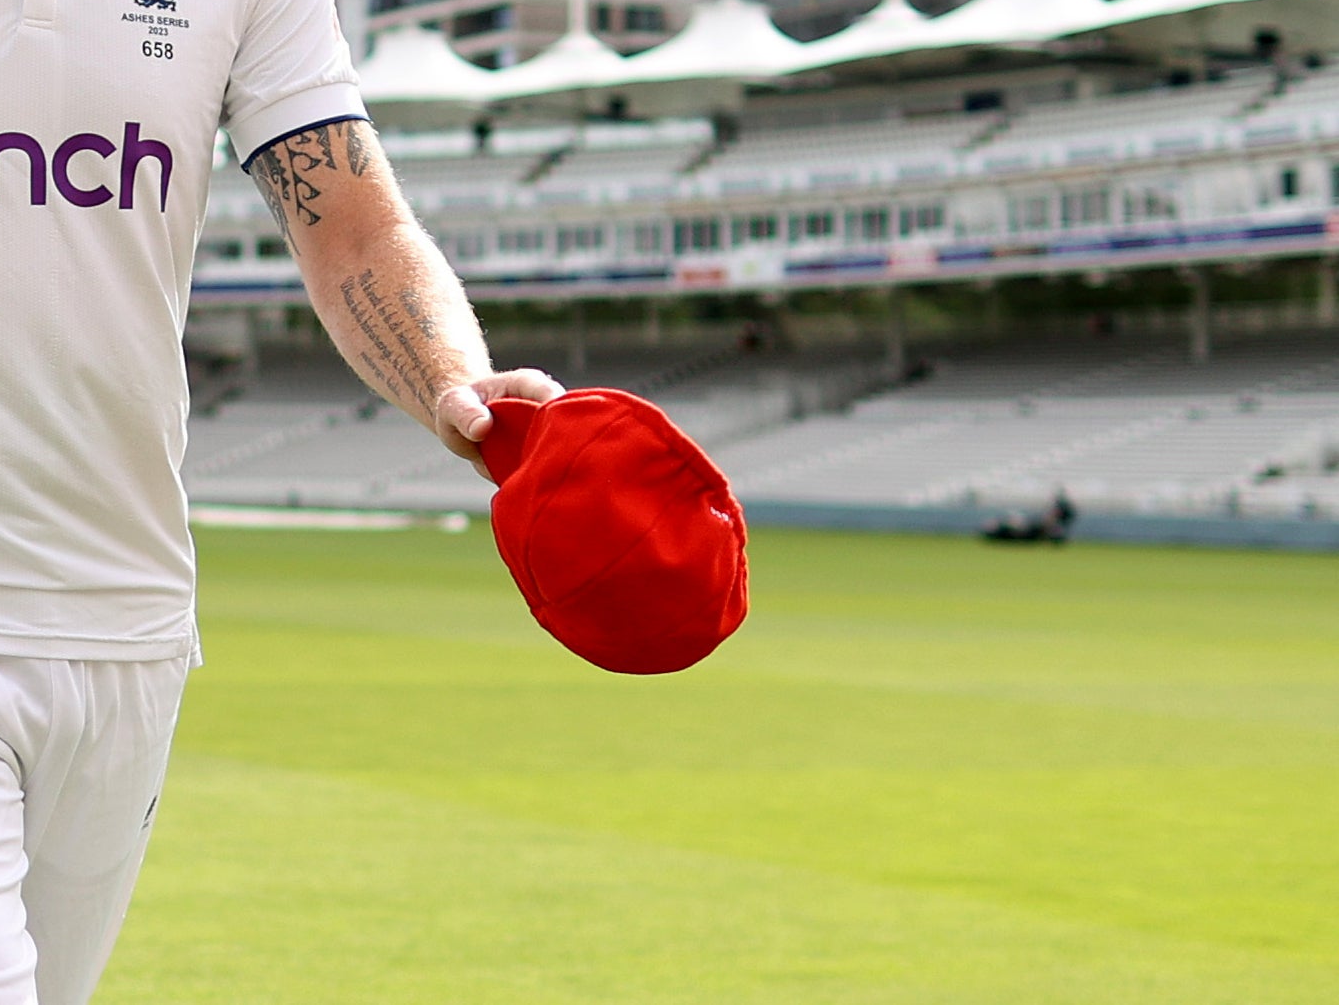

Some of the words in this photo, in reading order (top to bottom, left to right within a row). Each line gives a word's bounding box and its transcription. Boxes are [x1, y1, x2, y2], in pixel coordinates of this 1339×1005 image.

[121, 13, 154, 24] ASHES
[157, 16, 190, 28] SERIES
[148, 26, 169, 36] 2023
[142, 40, 173, 60] 658
